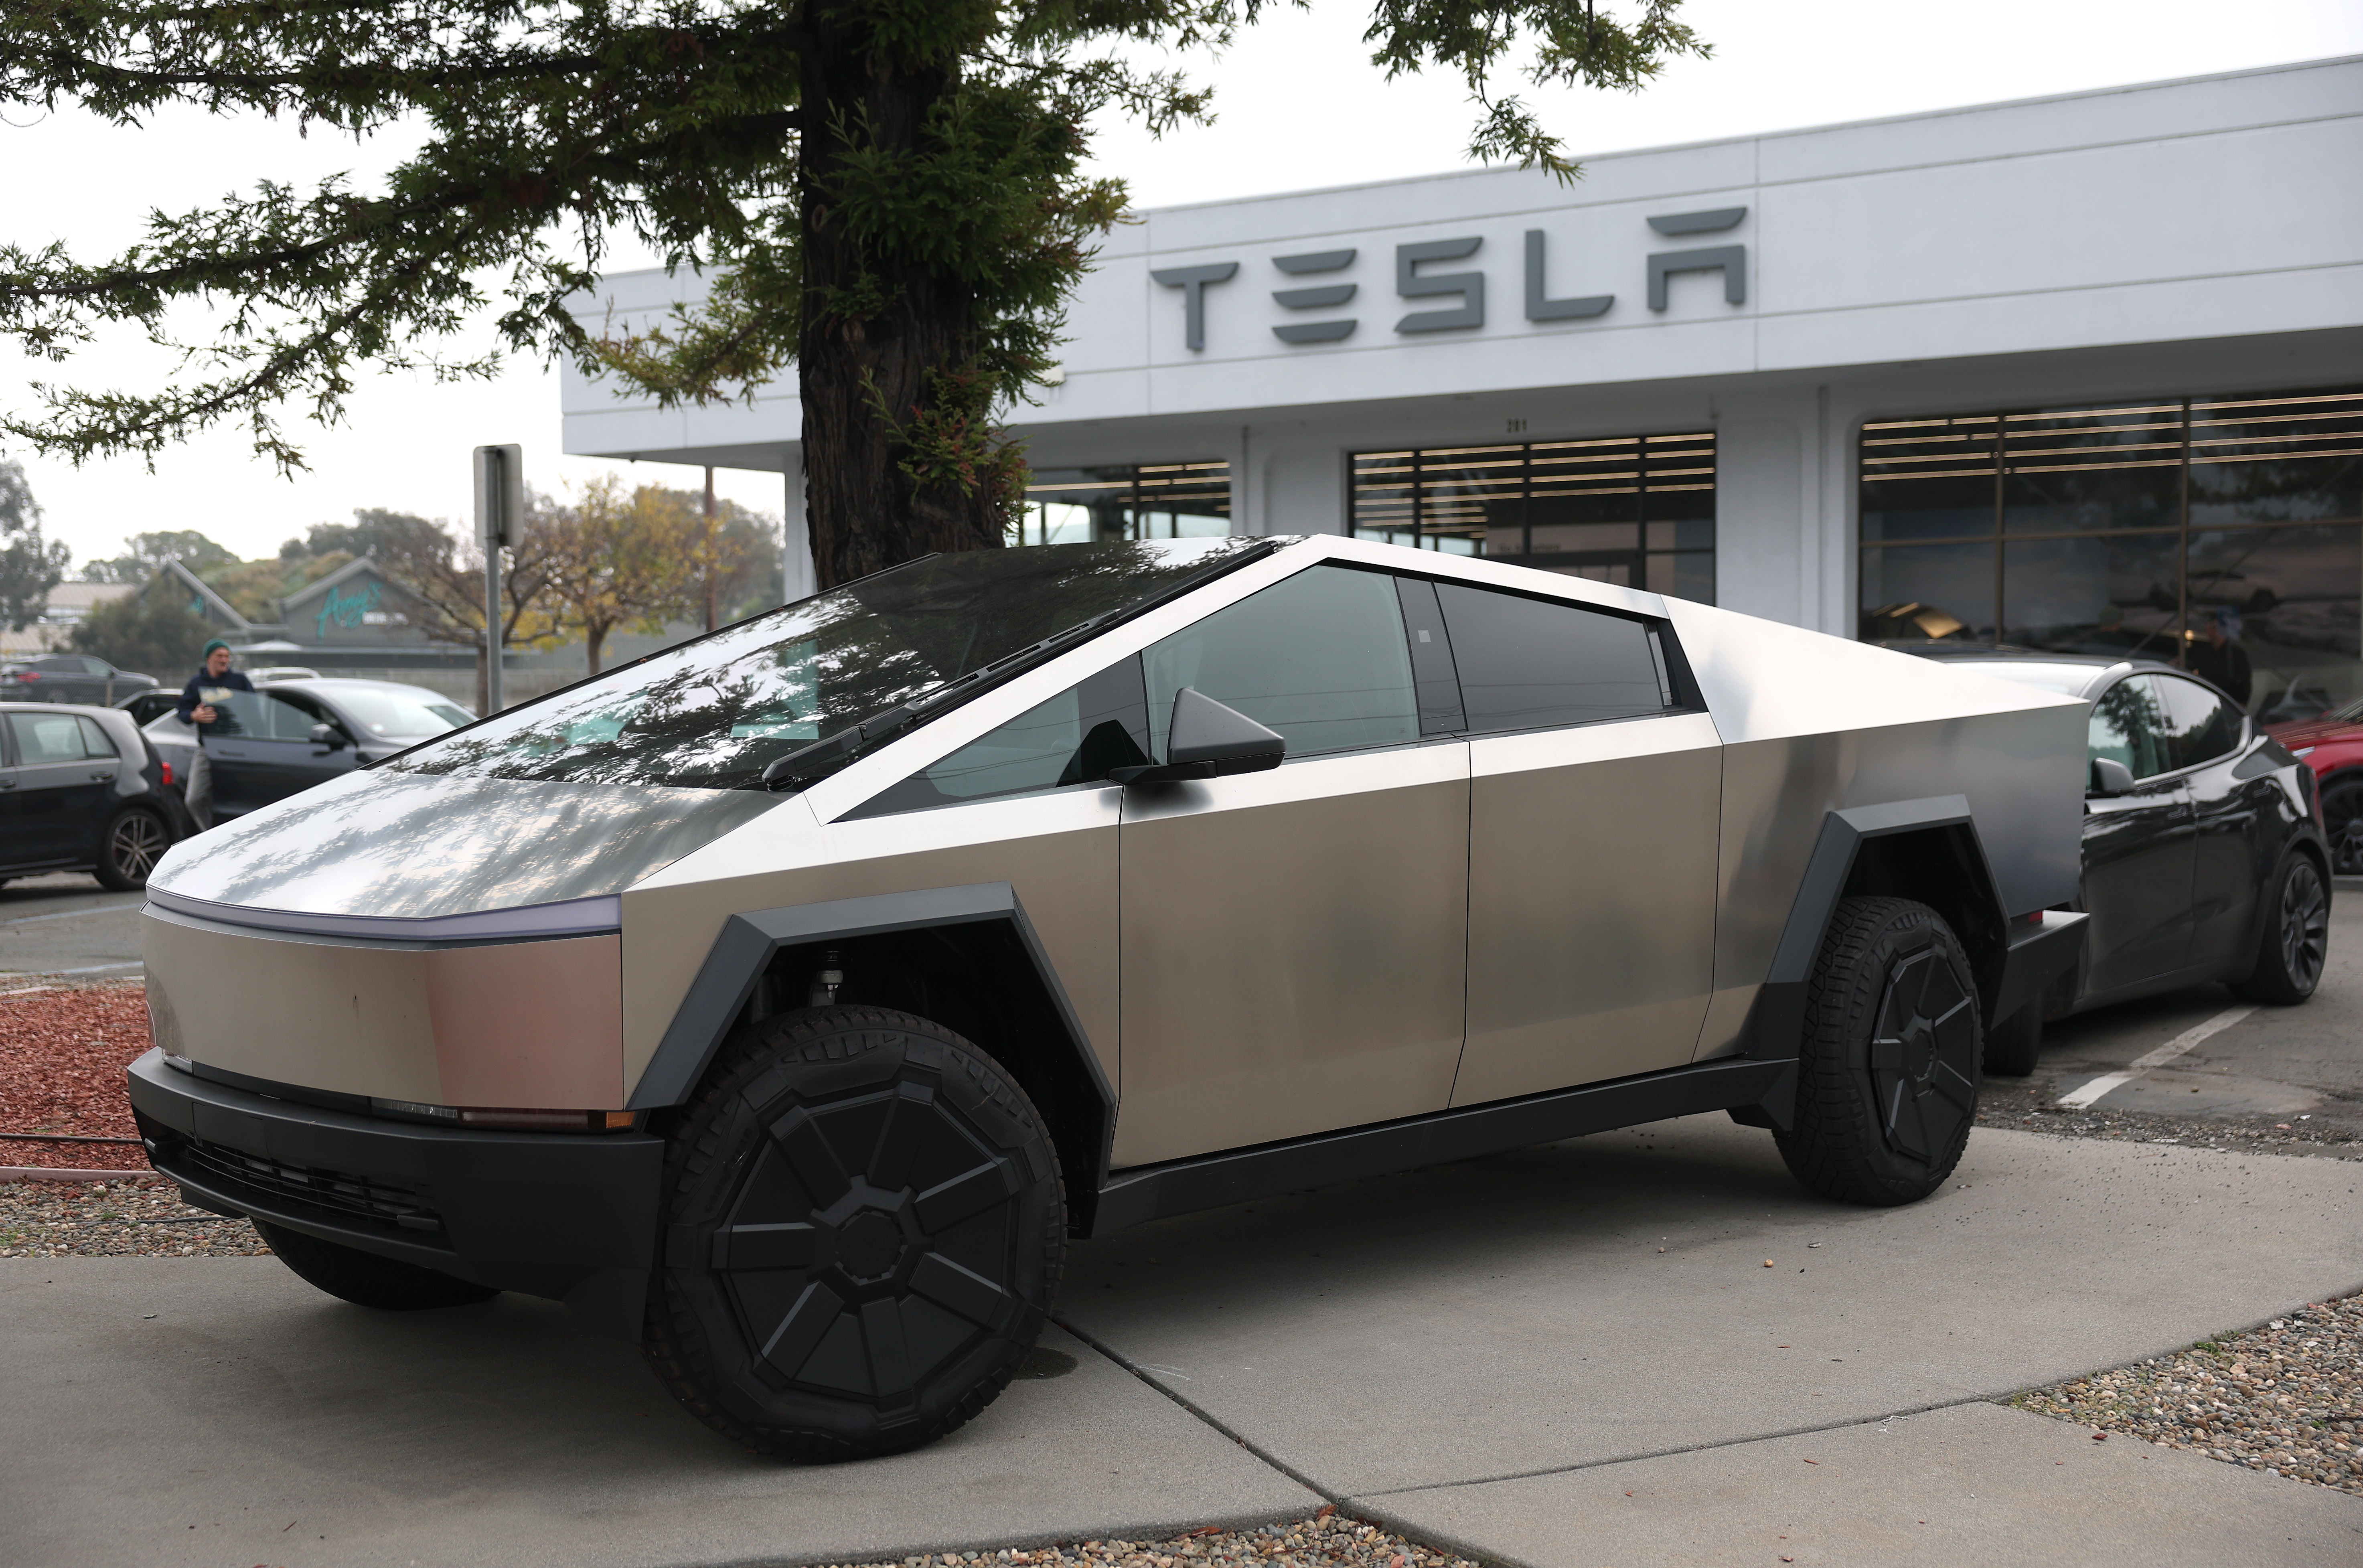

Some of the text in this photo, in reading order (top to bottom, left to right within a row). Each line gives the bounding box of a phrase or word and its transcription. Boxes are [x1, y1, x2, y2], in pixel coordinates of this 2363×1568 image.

[1149, 206, 1747, 352] TESLA
[1507, 418, 1527, 433] 201
[314, 581, 383, 638] Amy's
